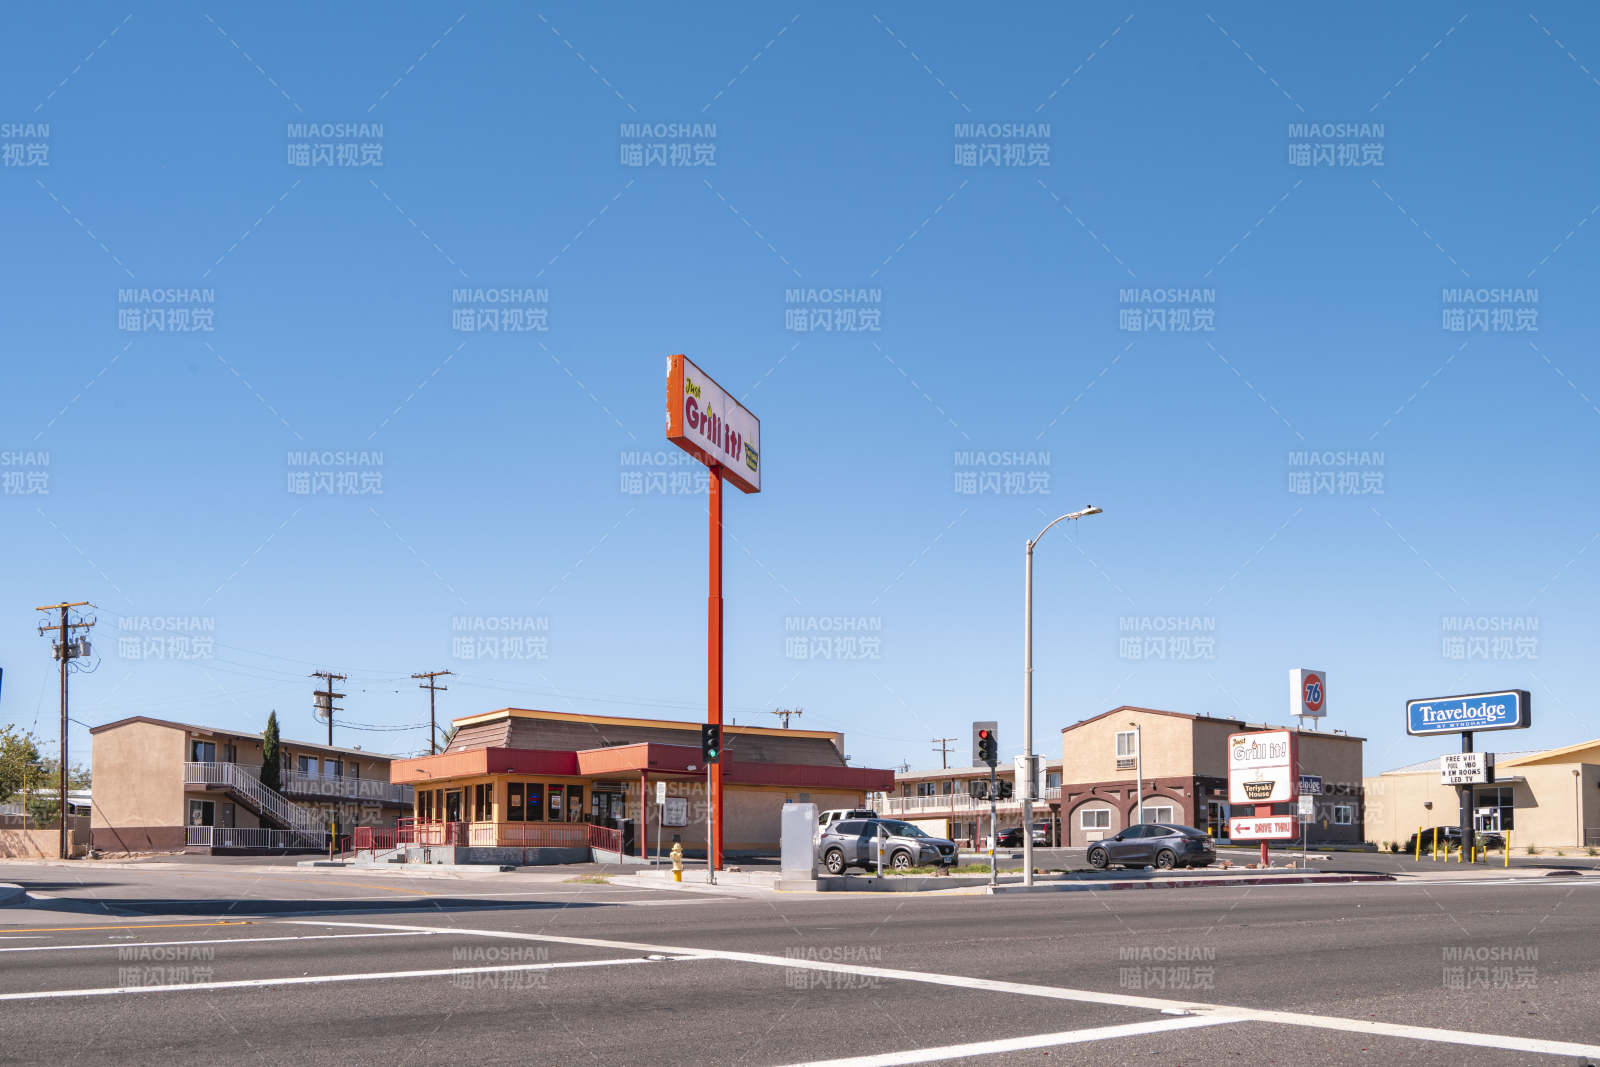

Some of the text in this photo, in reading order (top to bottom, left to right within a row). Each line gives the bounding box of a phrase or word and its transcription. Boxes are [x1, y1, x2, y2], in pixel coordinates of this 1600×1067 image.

[685, 377, 701, 399] Just
[685, 396, 722, 449] Grill
[725, 423, 742, 462] it!
[1305, 682, 1322, 704] 76
[1419, 702, 1506, 722] Travelodge
[1232, 737, 1246, 748] Just
[1233, 741, 1287, 761] Grill it!
[1245, 783, 1272, 793] Teriyaki
[1248, 790, 1271, 798] House
[1254, 822, 1290, 834] DRIVE THRU
